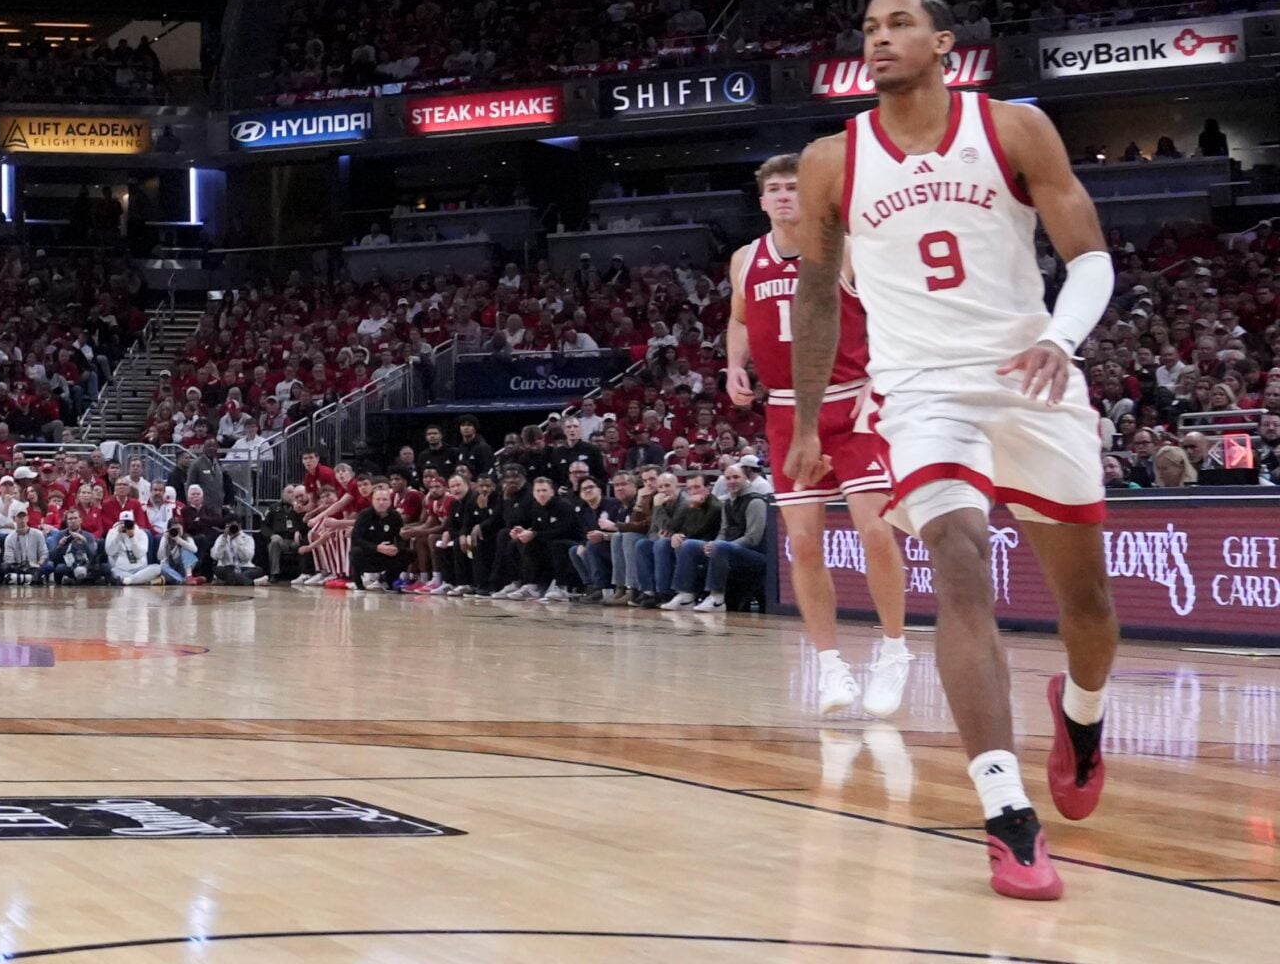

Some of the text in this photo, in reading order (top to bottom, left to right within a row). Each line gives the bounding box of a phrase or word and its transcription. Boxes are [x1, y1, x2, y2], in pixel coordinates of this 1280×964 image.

[1042, 38, 1168, 73] KeyBank
[412, 96, 554, 126] STEAK N SHAKE
[613, 77, 745, 111] SHIFT 4
[28, 122, 144, 137] LIFT ACADEMY
[271, 112, 371, 139] HYUNDAI
[34, 138, 142, 149] FLIGHT TRAINING
[862, 182, 998, 229] LOUISVILLE
[918, 230, 966, 292] 9
[1222, 536, 1280, 569] GIFT
[1104, 524, 1196, 616] LONE'S
[1212, 574, 1280, 608] CARD
